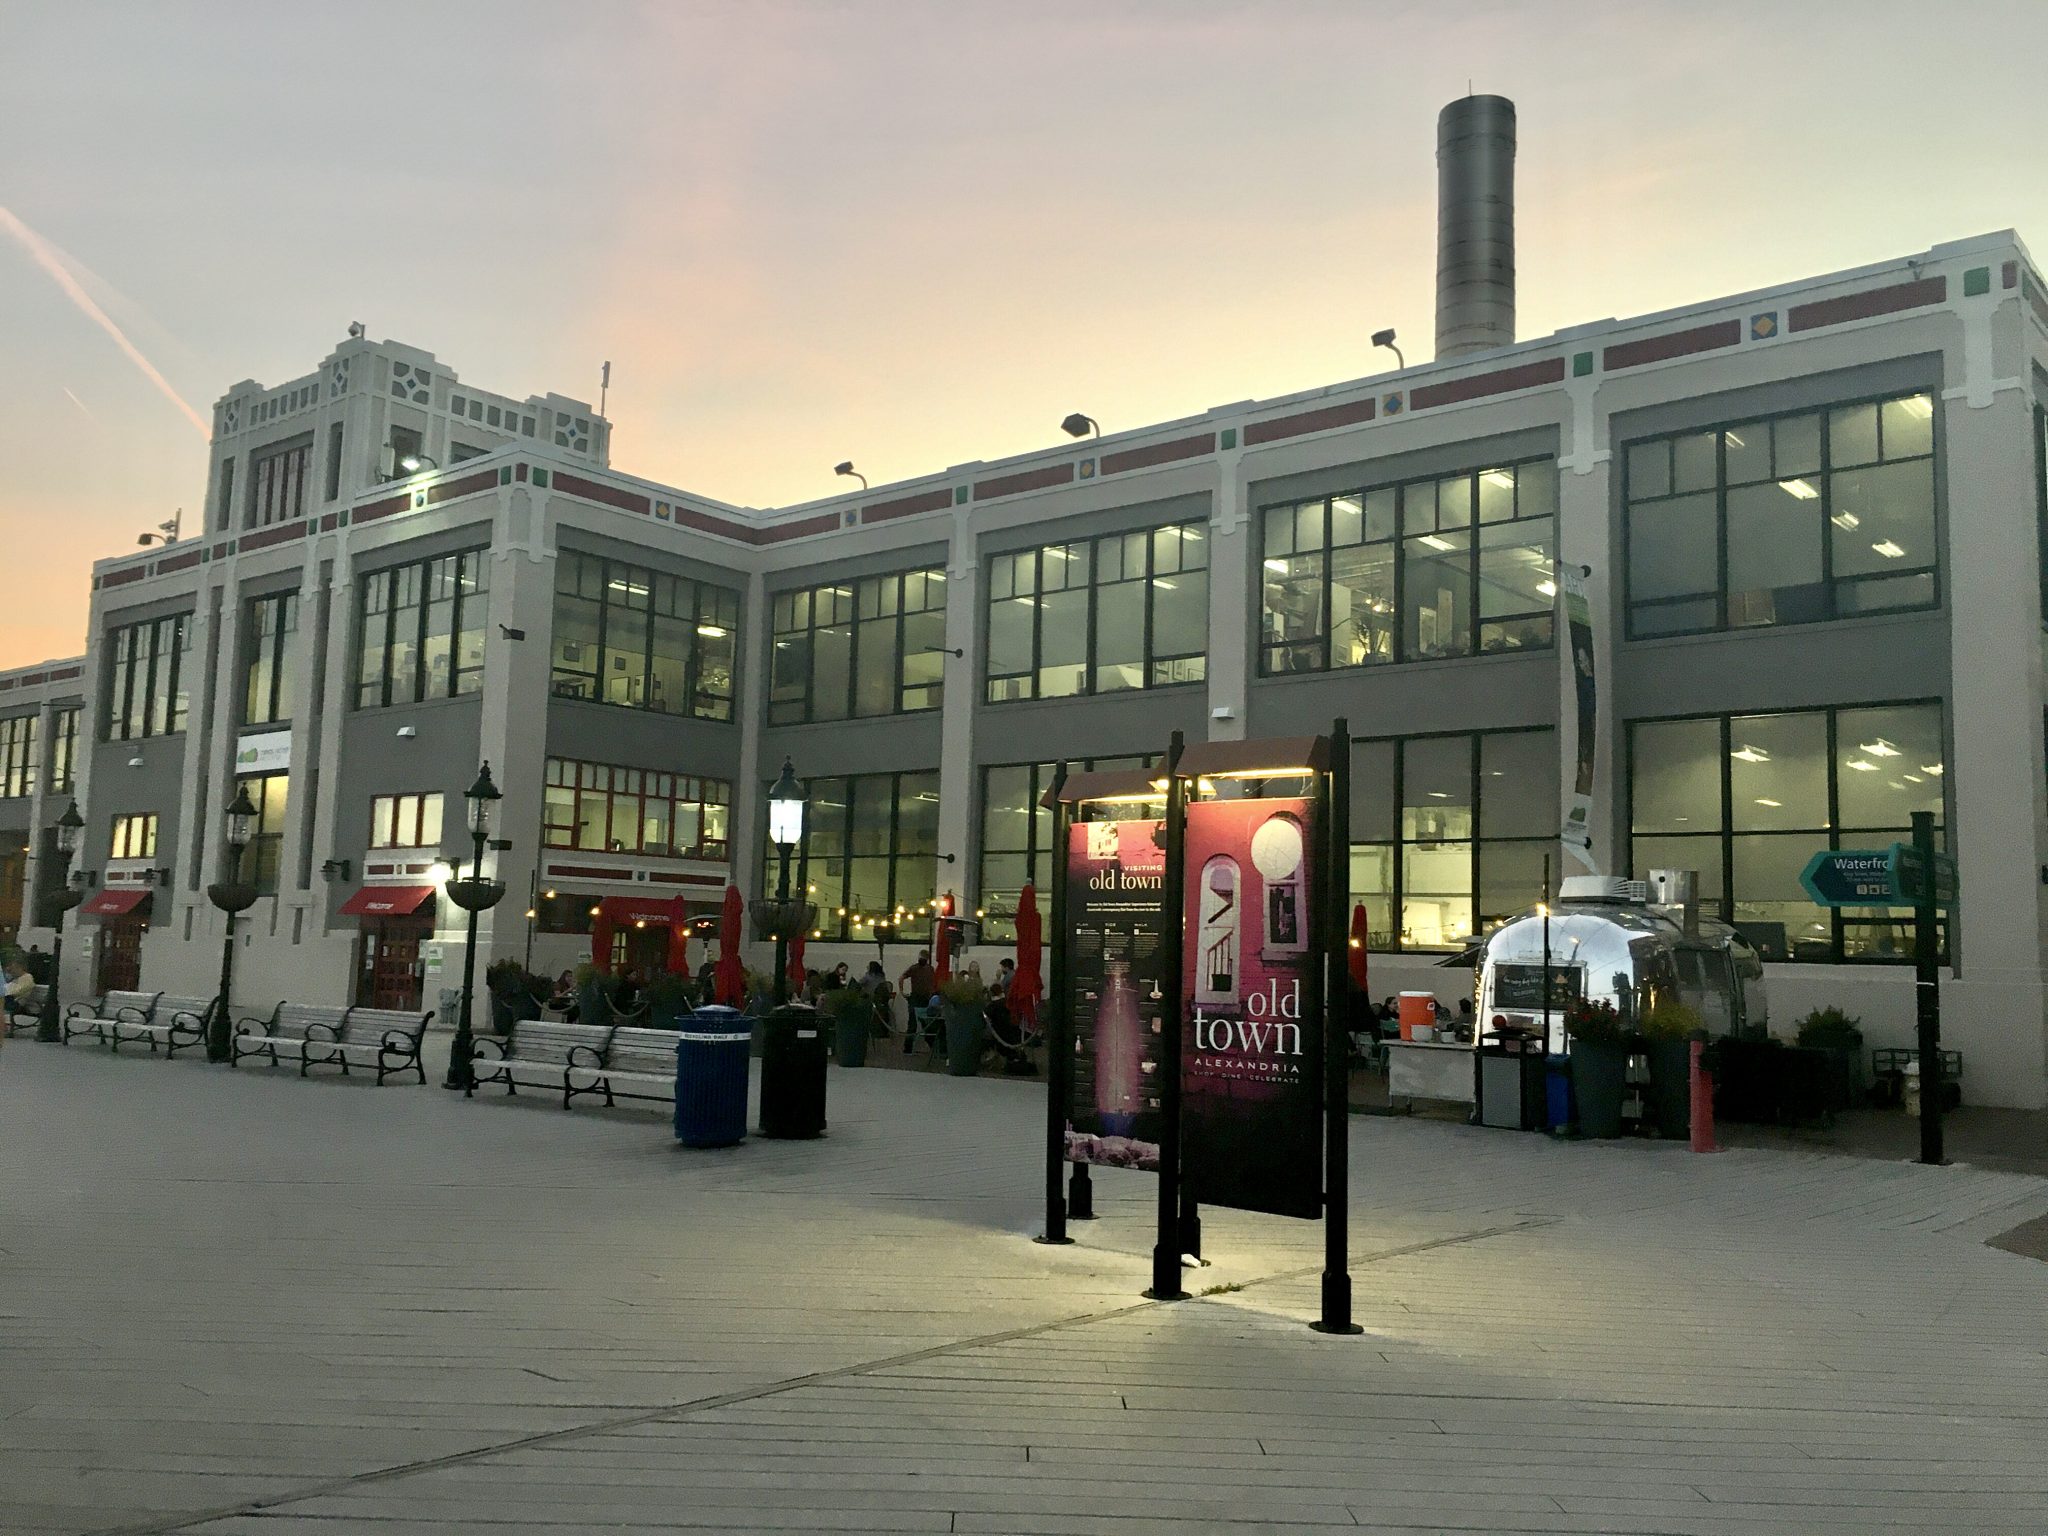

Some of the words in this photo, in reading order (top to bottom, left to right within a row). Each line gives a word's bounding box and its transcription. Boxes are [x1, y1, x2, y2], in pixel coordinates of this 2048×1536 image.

[1089, 869, 1115, 890] old
[1120, 872, 1162, 889] town
[1247, 978, 1302, 1019] old
[1193, 1007, 1304, 1056] town
[1194, 1058, 1300, 1073] ALEXANDRIA
[1249, 1074, 1300, 1084] CELEBRATE
